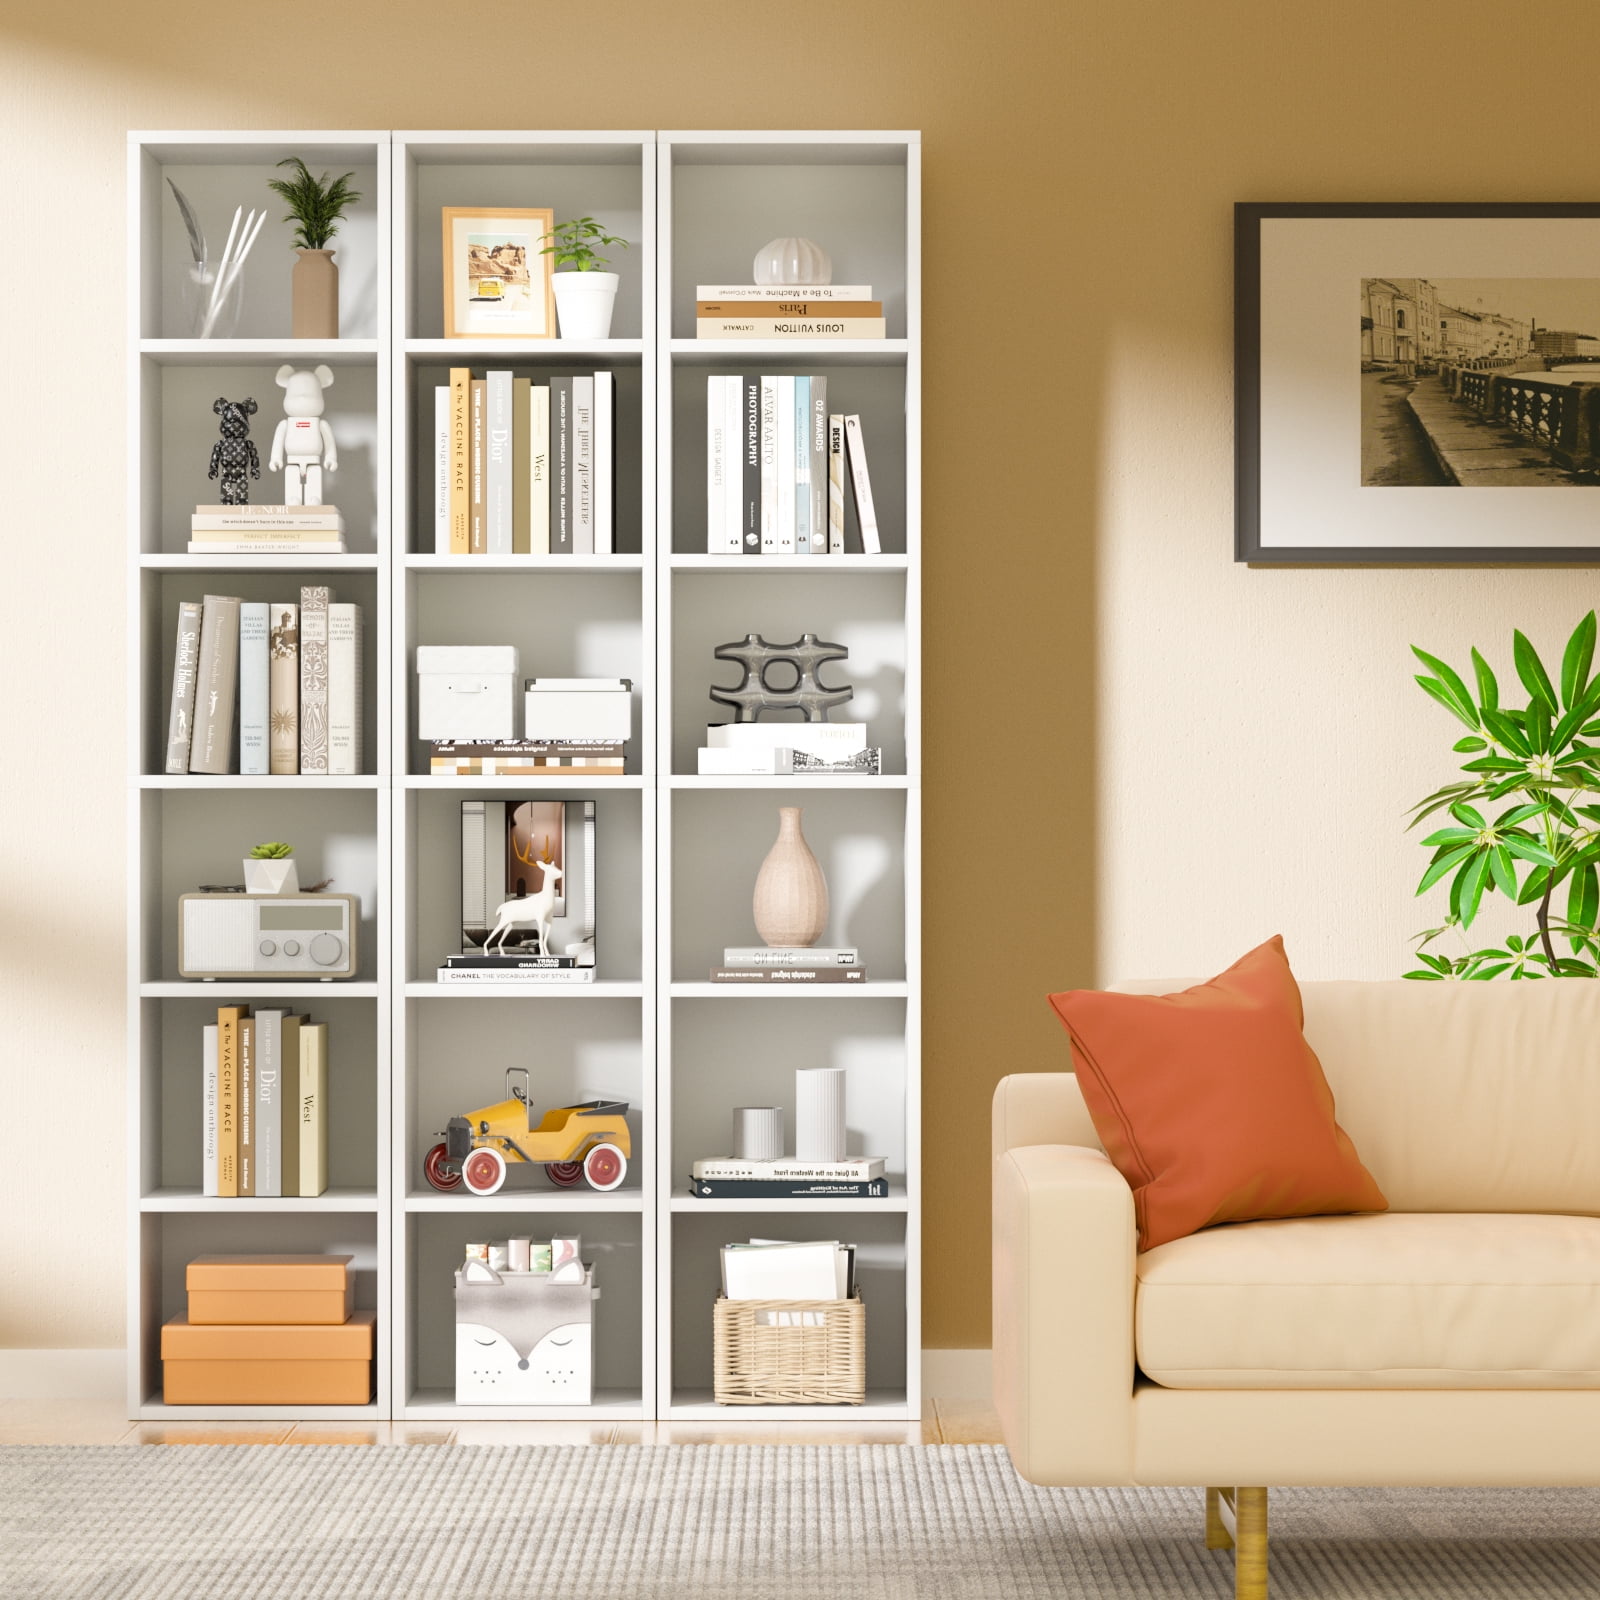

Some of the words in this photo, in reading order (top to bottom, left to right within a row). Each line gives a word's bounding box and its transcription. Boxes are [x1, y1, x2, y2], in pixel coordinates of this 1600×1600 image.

[779, 304, 807, 315] Paris
[774, 324, 813, 332] VUITTON
[817, 324, 844, 332] LOUIS
[764, 387, 773, 423] ALVAR
[748, 385, 757, 466] PHOTOGRAPHY
[832, 428, 840, 454] DESIGN
[439, 432, 448, 466] design
[491, 428, 508, 464] Dior
[764, 427, 773, 464] AALTO
[534, 454, 545, 482] West
[714, 458, 722, 486] GADGETS
[263, 506, 289, 514] NOIR
[439, 469, 448, 519] anthology
[179, 632, 195, 666] Sherlock
[177, 669, 192, 698] Holmes
[208, 1072, 216, 1106] design
[260, 1070, 276, 1104] Dior
[304, 1095, 314, 1123] West
[208, 1109, 216, 1160] anthology
